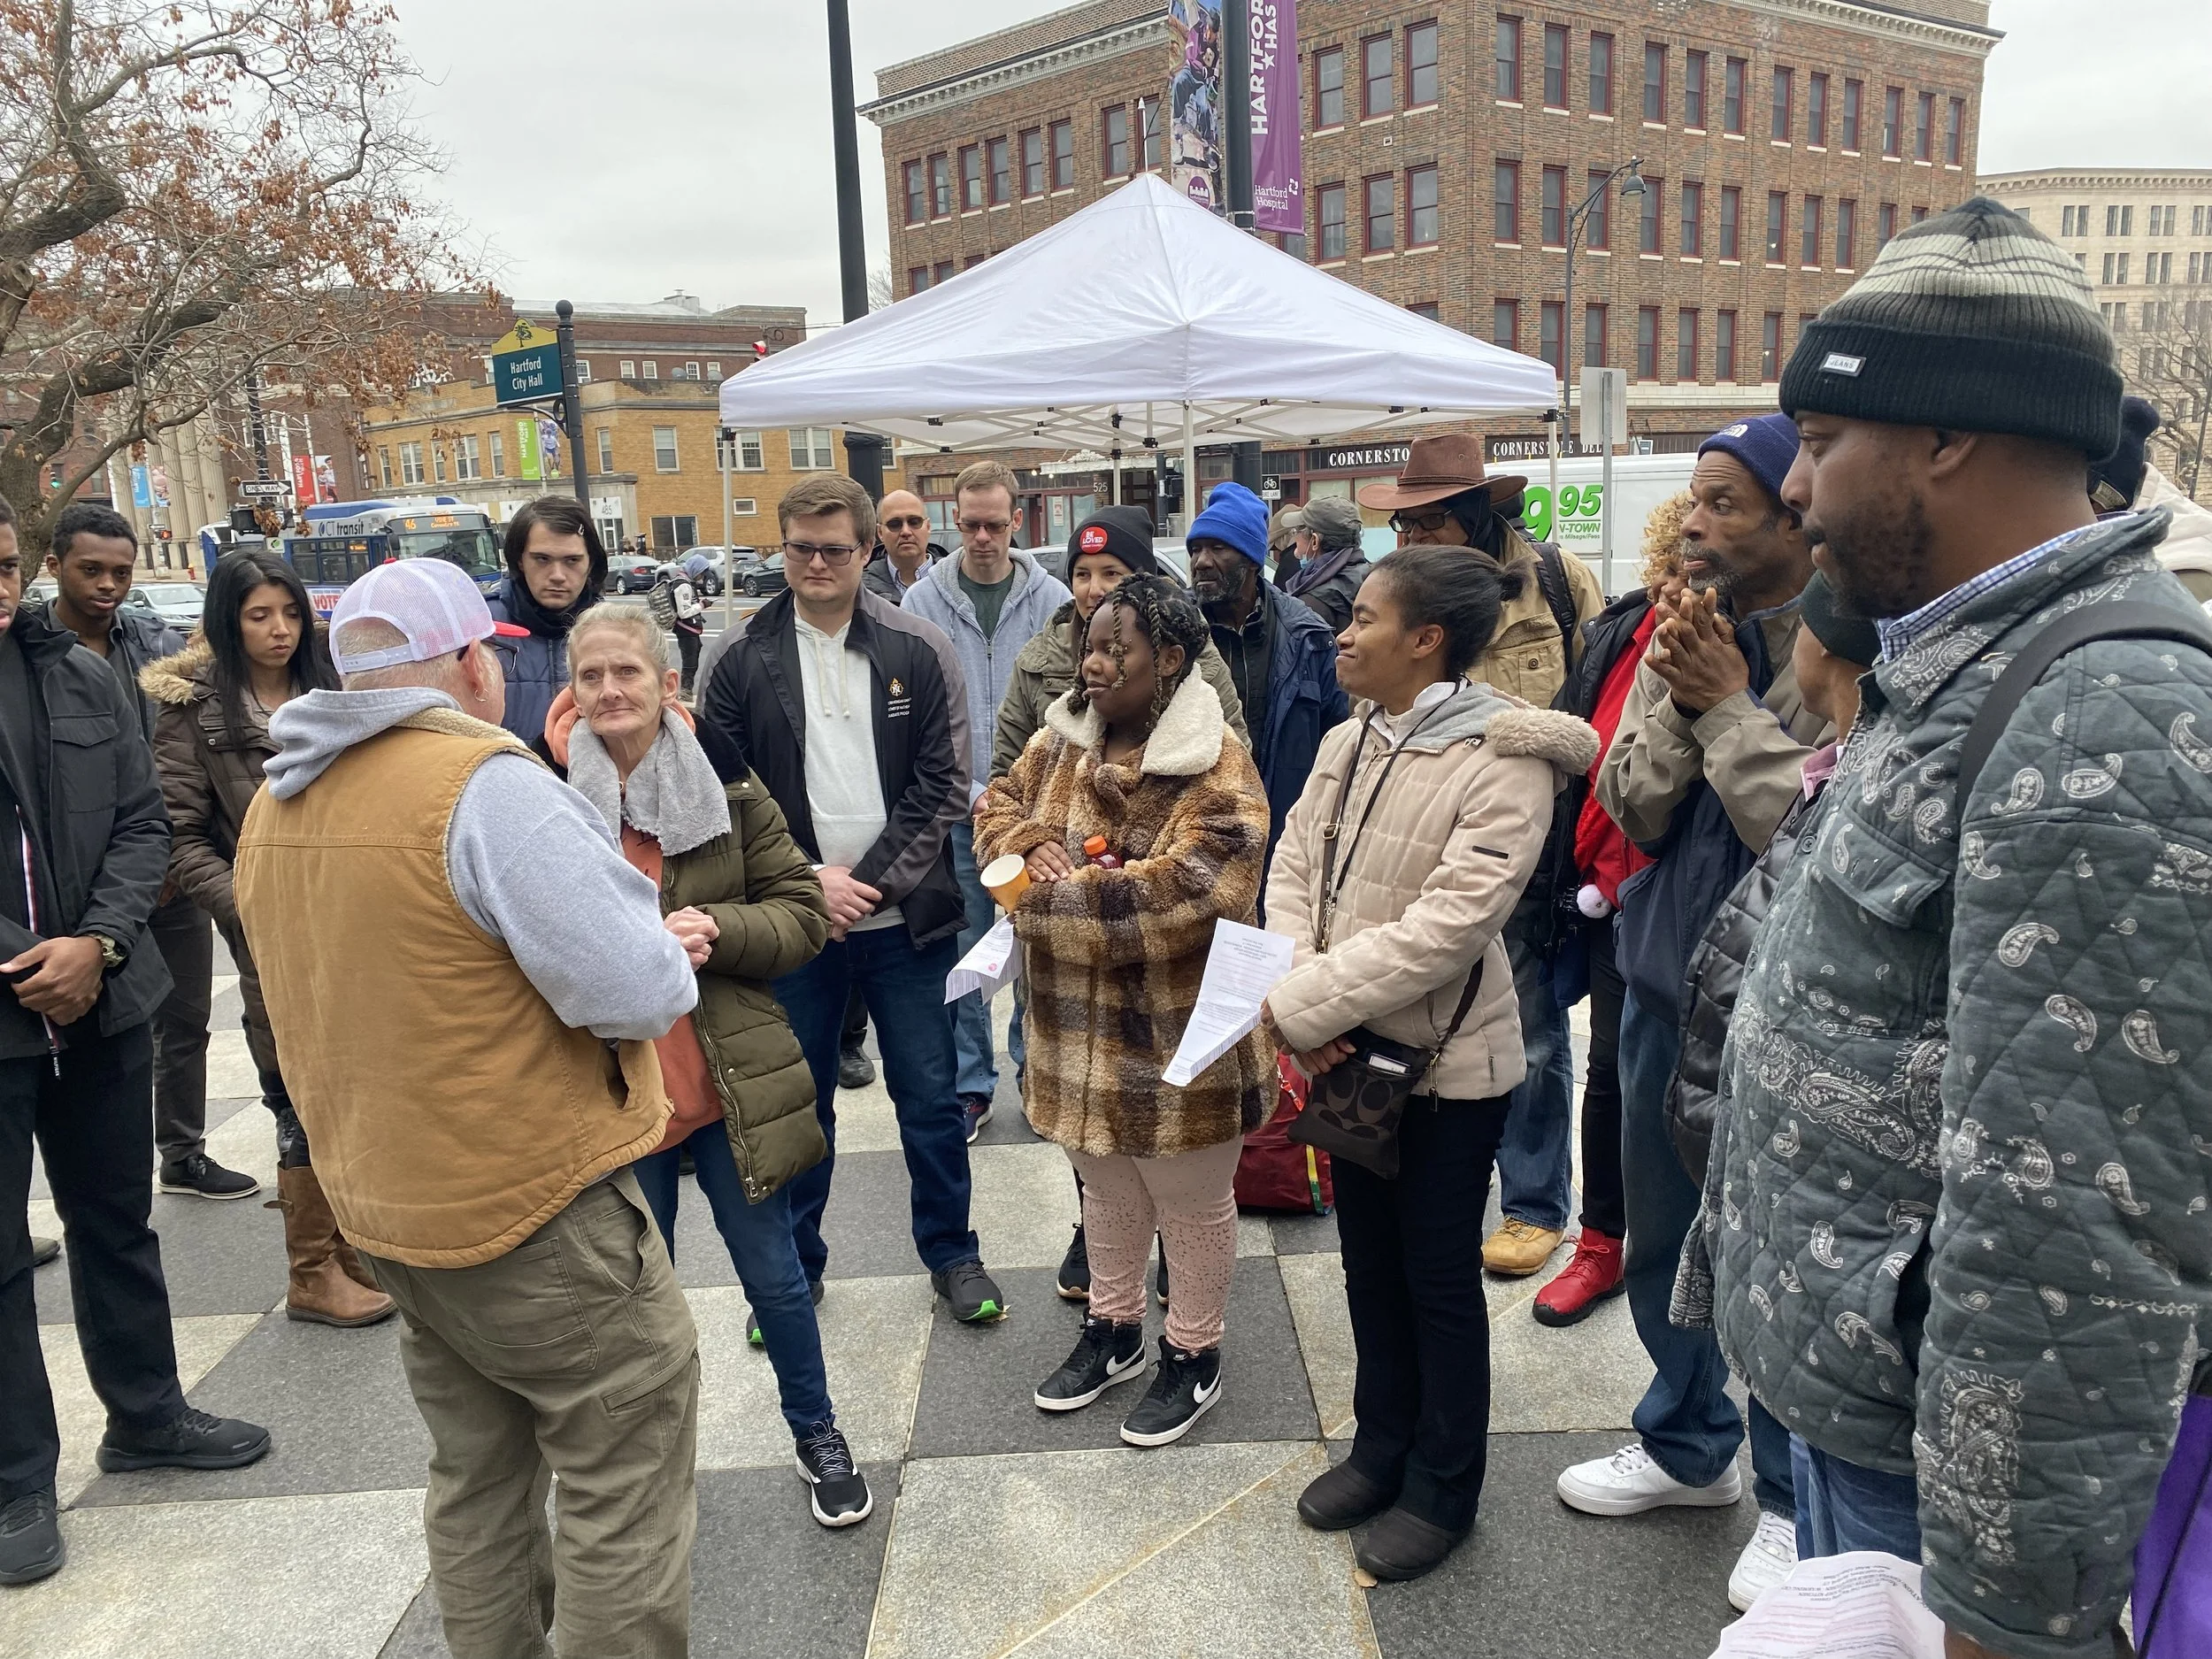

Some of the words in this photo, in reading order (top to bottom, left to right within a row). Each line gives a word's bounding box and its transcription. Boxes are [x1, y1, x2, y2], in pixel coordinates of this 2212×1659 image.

[1264, 4, 1277, 49] HAS
[1254, 184, 1288, 198] Hartford
[1256, 196, 1289, 211] Hospital
[510, 357, 541, 374] Hartford
[1829, 360, 1854, 369] JEANS
[511, 378, 527, 392] City
[528, 373, 543, 388] Hall
[1494, 441, 1574, 457] CORNERSTE
[1093, 482, 1109, 493] 525
[1558, 485, 1604, 518] 95
